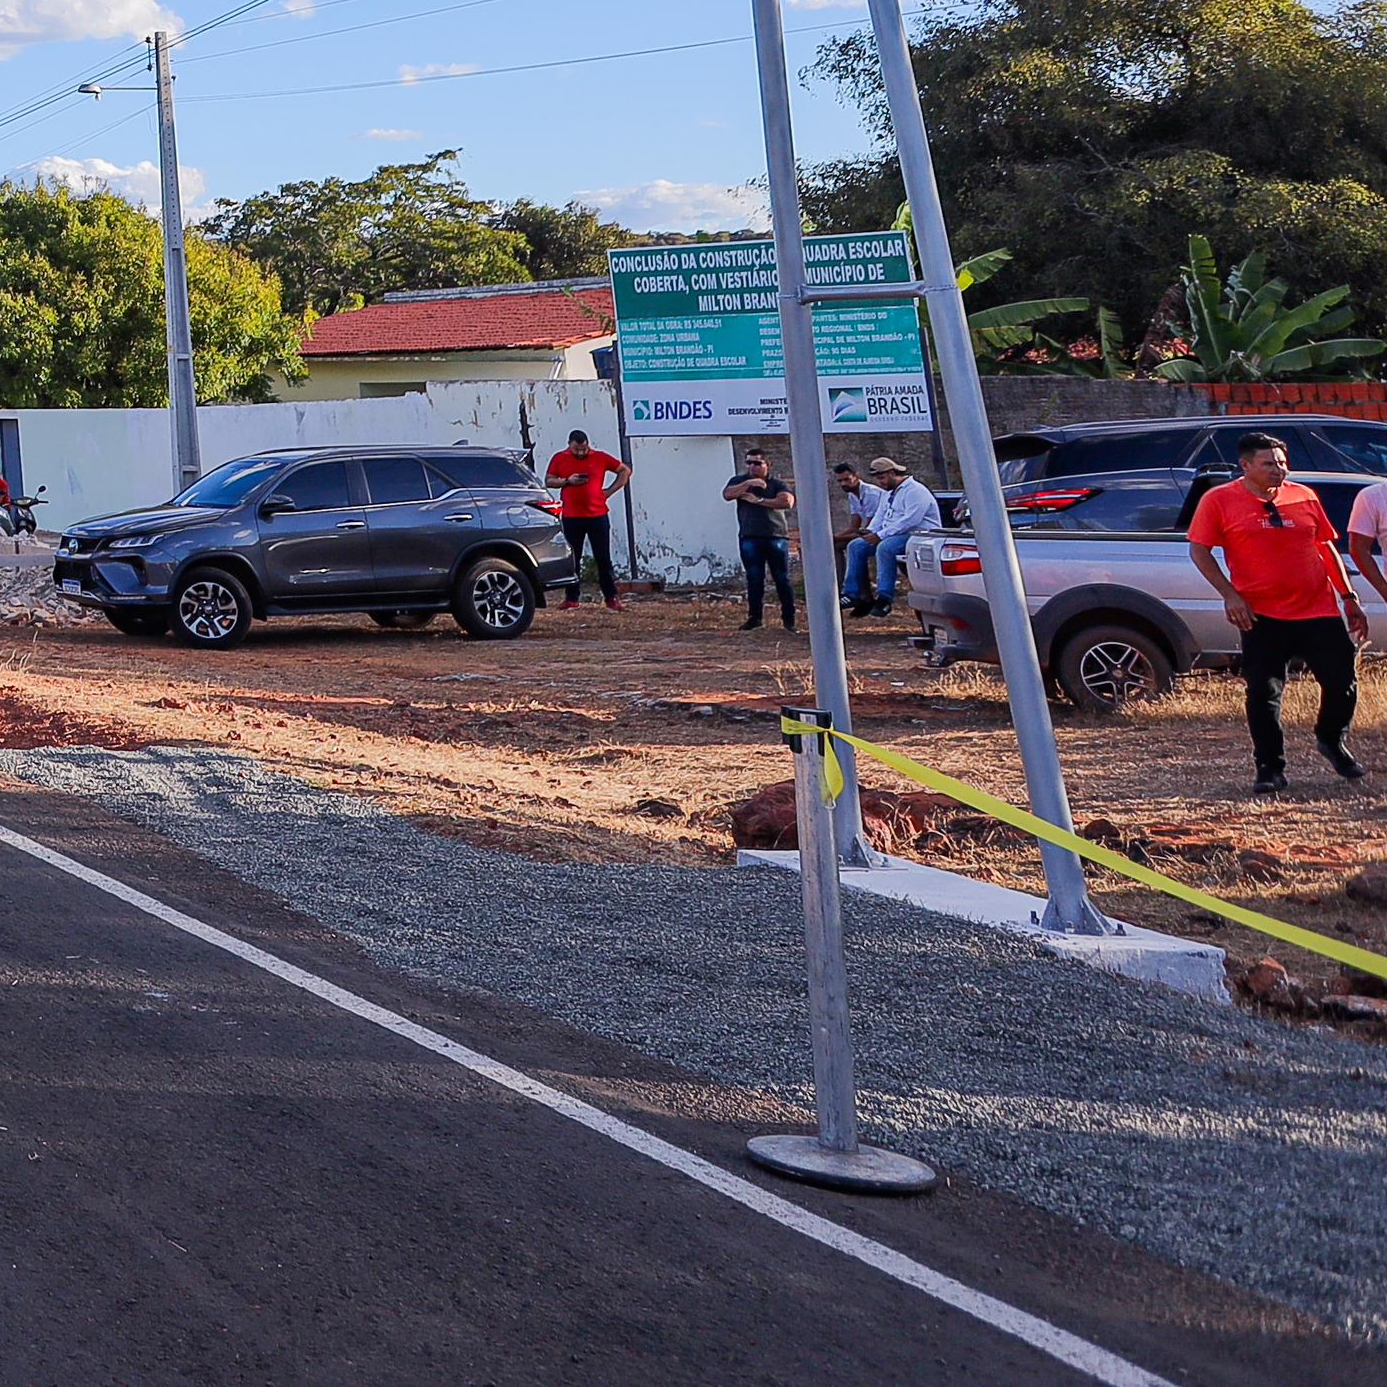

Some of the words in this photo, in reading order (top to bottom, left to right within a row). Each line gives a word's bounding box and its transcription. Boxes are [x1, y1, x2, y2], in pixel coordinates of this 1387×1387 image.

[611, 251, 678, 273] CONCLUSÃO
[681, 251, 698, 270] DA
[699, 245, 776, 269] CONSTRUÇÃO
[849, 240, 905, 259] ESCOLAR
[633, 274, 689, 294] COBERTA,
[691, 273, 718, 291] COM
[868, 263, 885, 281] DE
[698, 294, 741, 312] MILTON
[744, 292, 779, 310] BRAN
[865, 385, 893, 396] PÁTRIA
[894, 385, 924, 396] AMADA
[654, 400, 712, 420] BNDES
[867, 396, 927, 415] BRASIL
